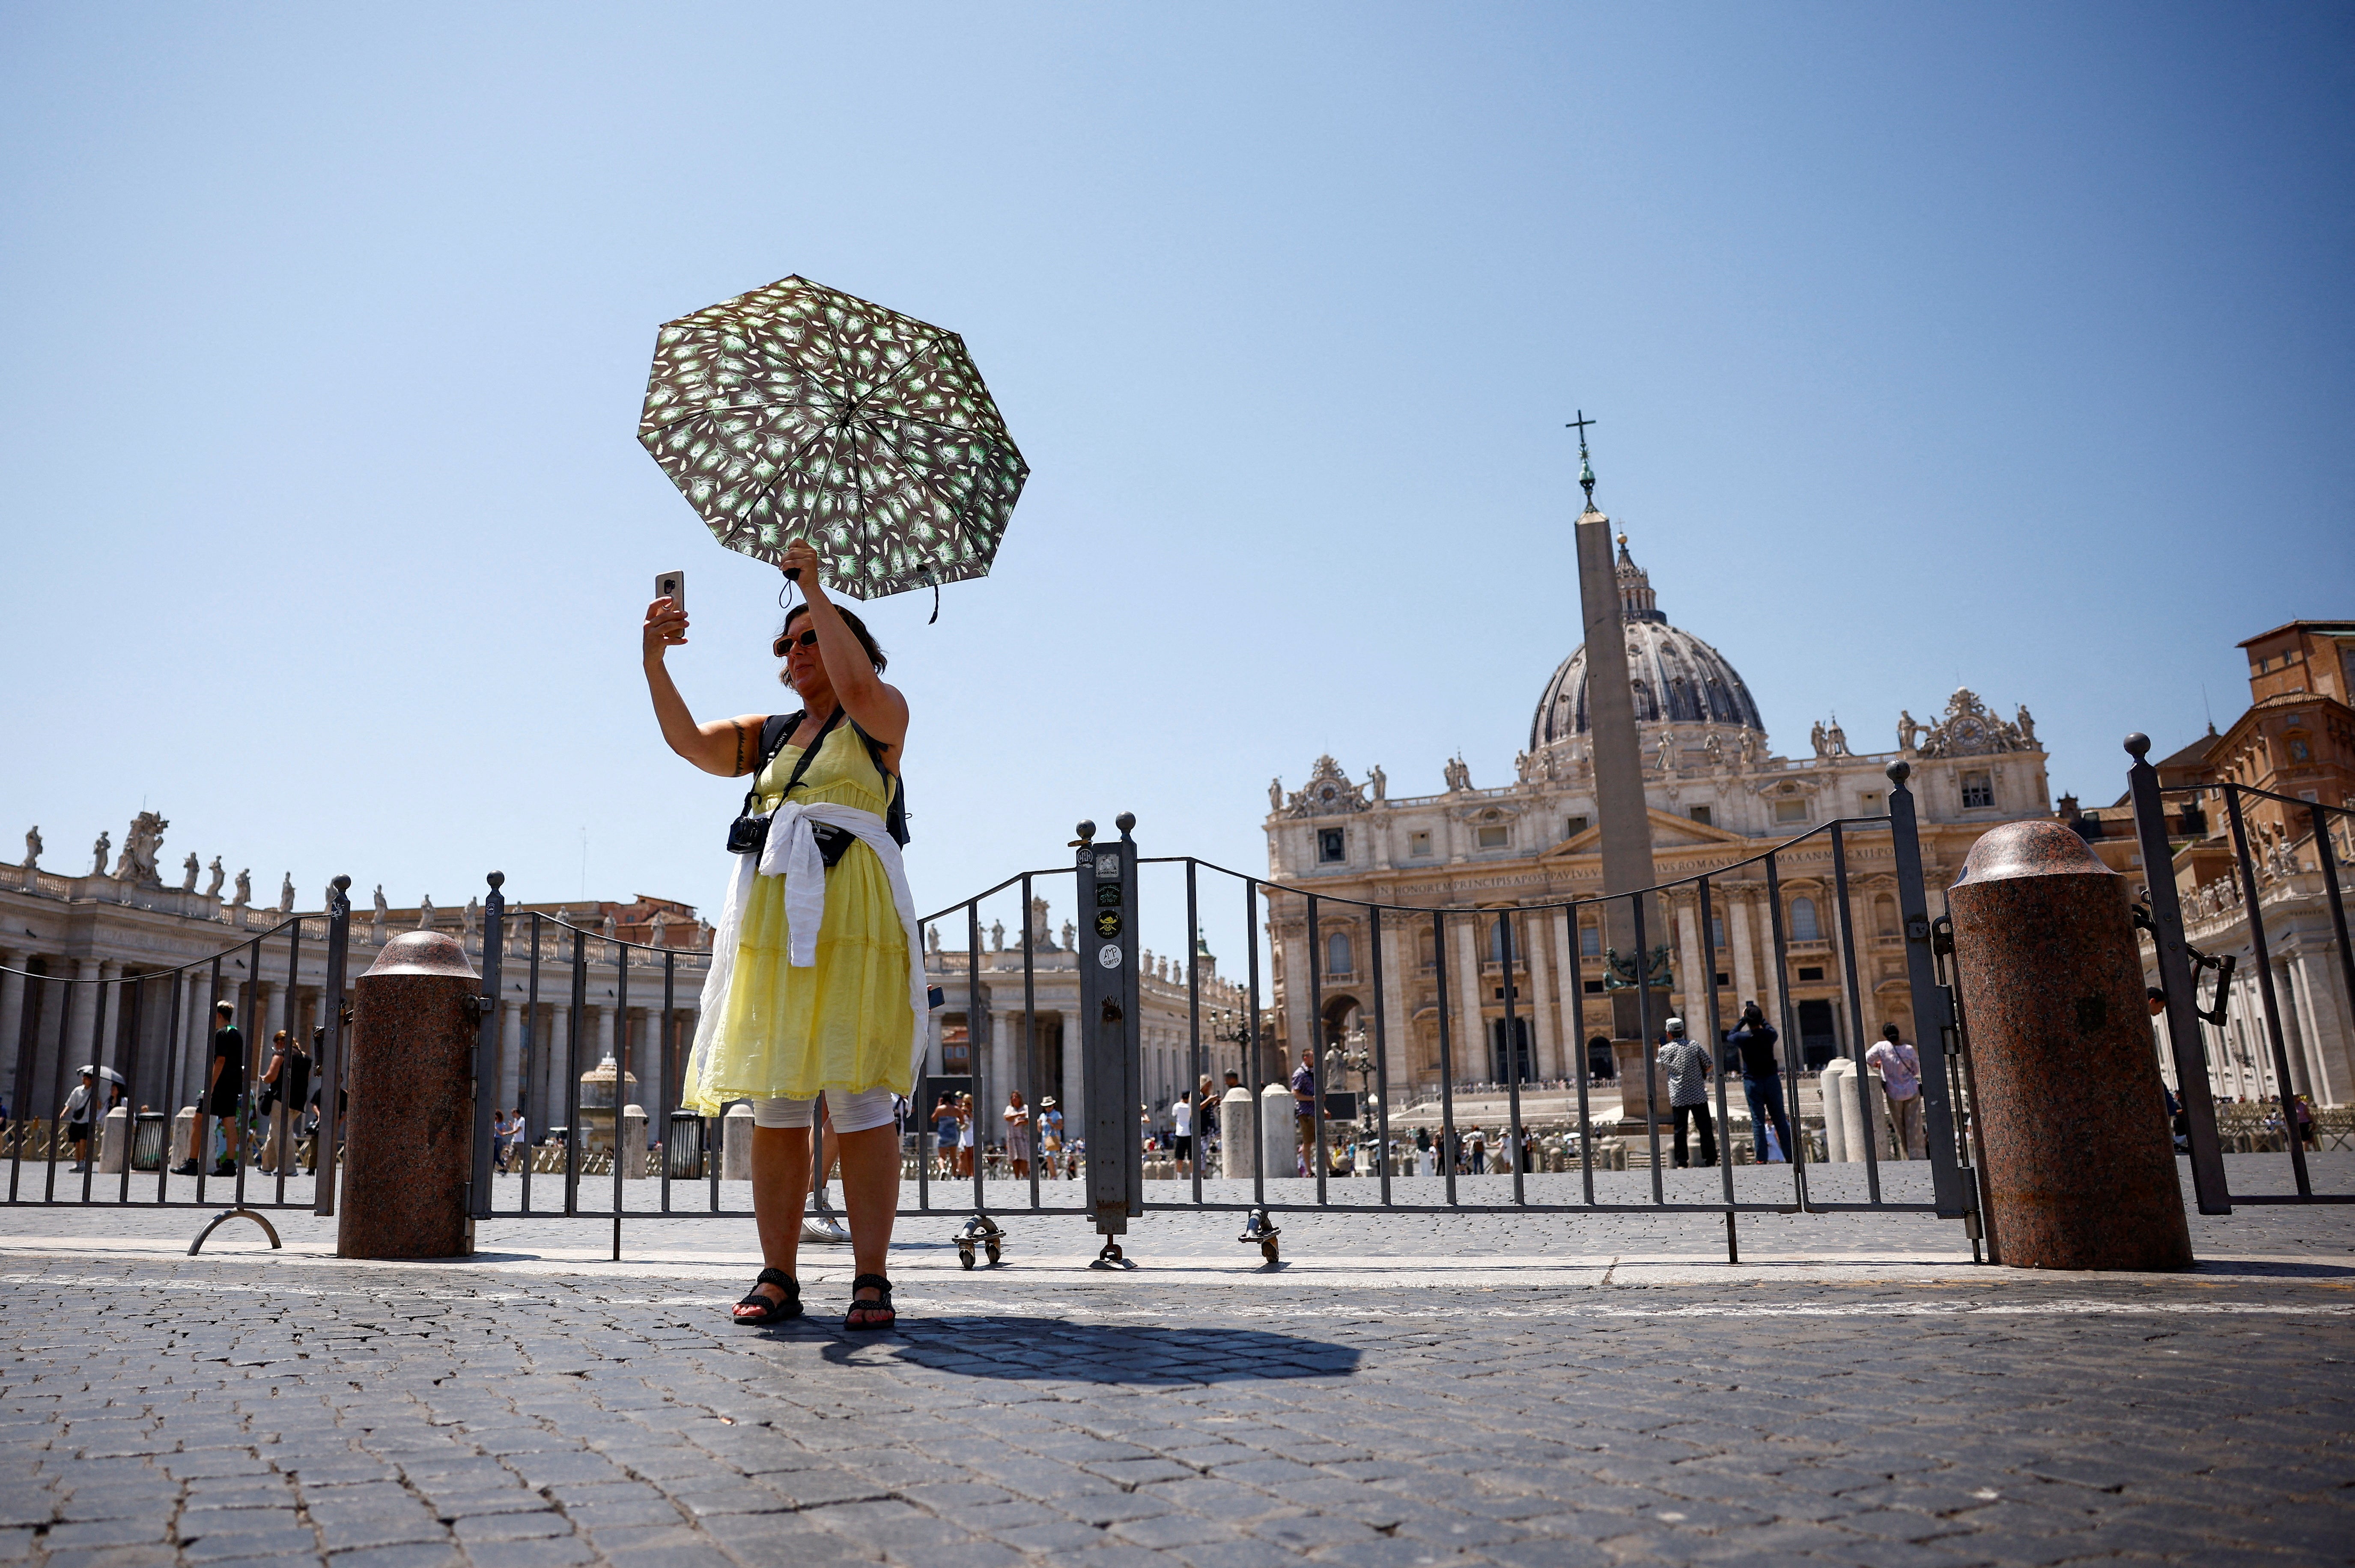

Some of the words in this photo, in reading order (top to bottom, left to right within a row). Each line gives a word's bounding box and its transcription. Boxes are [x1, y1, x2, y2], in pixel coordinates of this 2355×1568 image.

[775, 732, 787, 748] SONY
[1375, 886, 1389, 896] IN
[1395, 882, 1452, 894] HONOREM
[1454, 877, 1512, 889] PRINCIPIS
[1514, 873, 1548, 884] APOST
[1777, 852, 1803, 863] MAX
[1104, 947, 1117, 960] AMP
[1104, 958, 1119, 966] SURFER
